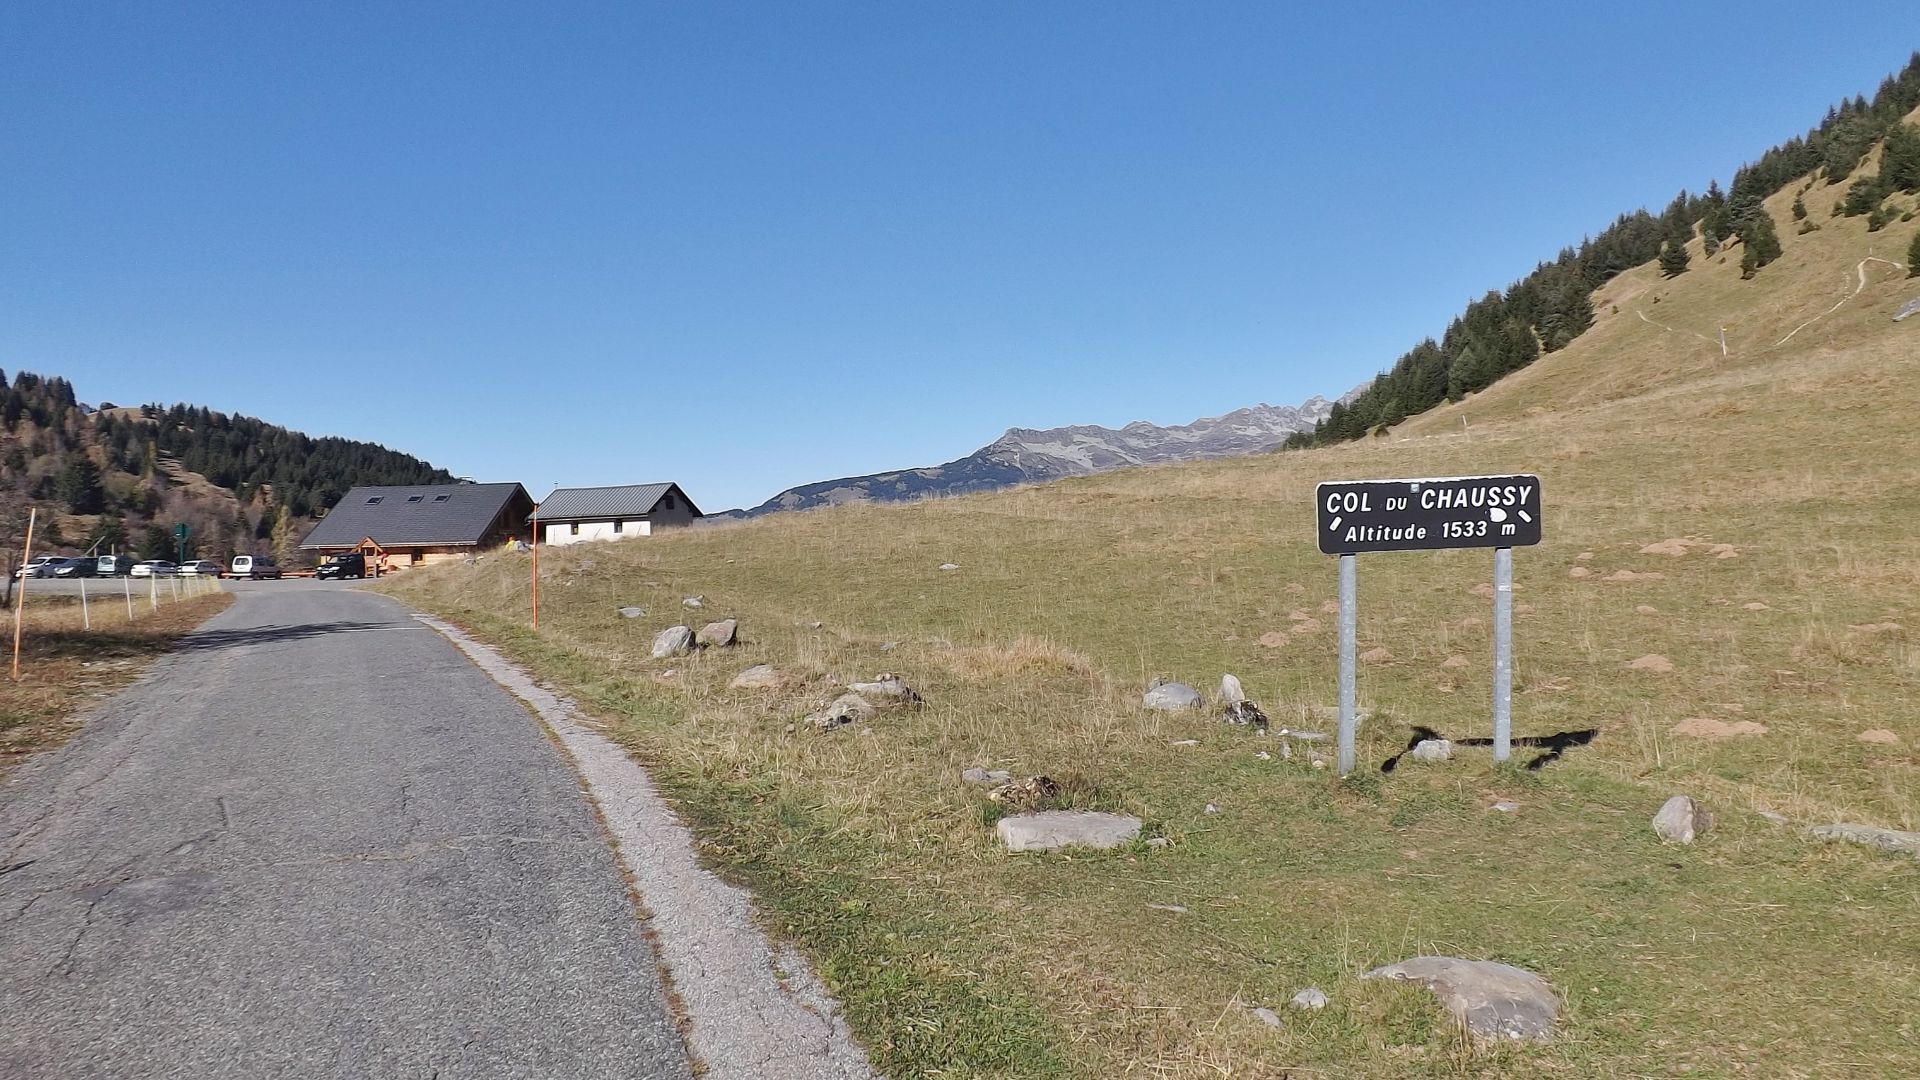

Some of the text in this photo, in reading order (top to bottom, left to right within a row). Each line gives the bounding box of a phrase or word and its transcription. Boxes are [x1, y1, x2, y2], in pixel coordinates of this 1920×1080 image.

[1326, 485, 1532, 513] COL DU CHAUSSY
[1344, 521, 1516, 542] Altitude 1533 m
